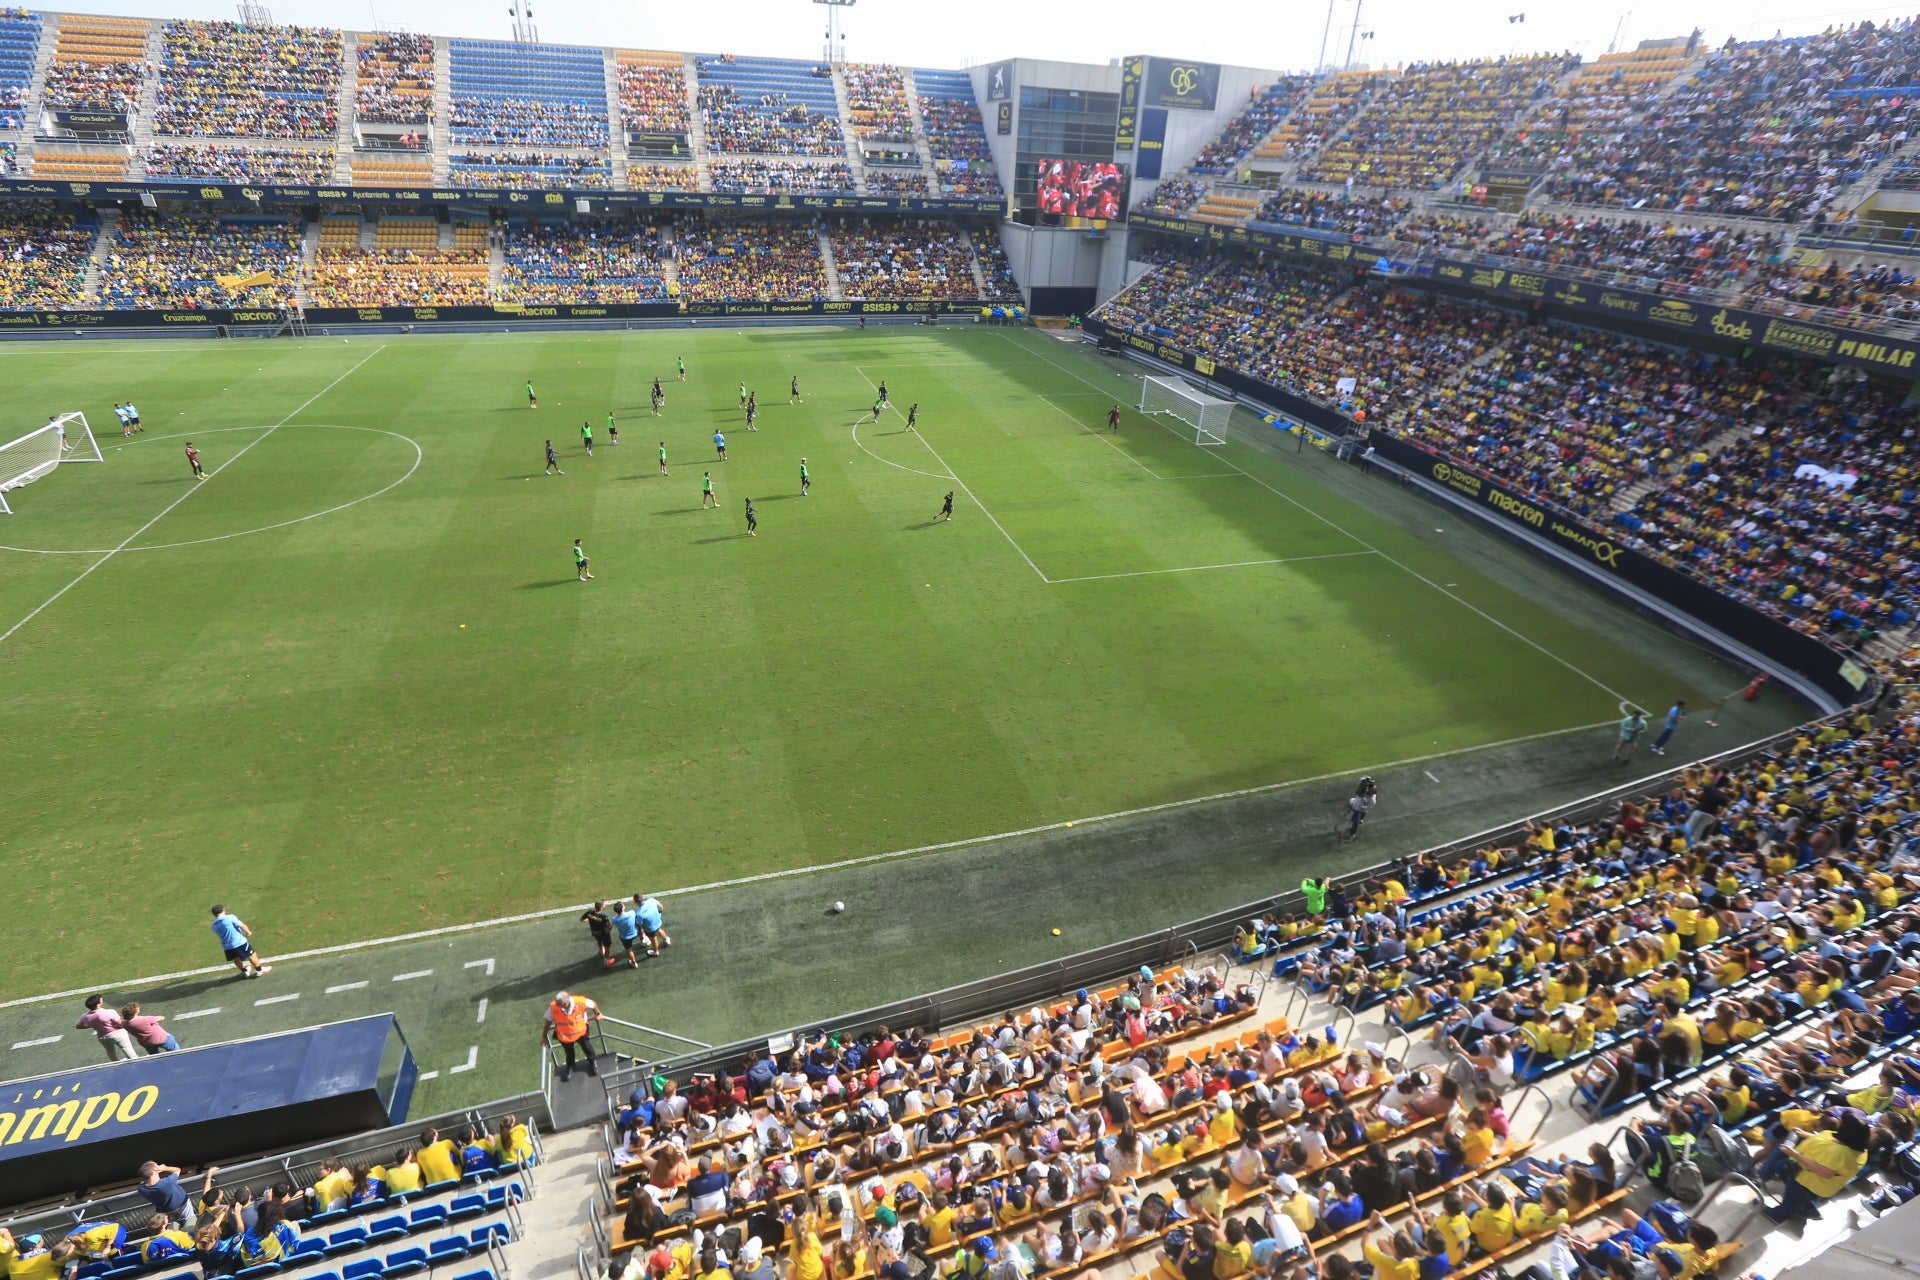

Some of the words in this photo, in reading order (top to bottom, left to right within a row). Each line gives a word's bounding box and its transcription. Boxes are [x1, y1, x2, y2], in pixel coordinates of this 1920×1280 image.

[353, 191, 390, 199] Ayuntamiento
[403, 191, 420, 199] Cádiz
[1510, 273, 1548, 291] RESET
[571, 308, 606, 316] Cruzcampo
[862, 303, 891, 312] asisa
[163, 314, 207, 322] Cruzcampo
[1130, 336, 1154, 353] macron
[1451, 469, 1481, 490] TOYOTA
[1488, 489, 1545, 527] macron
